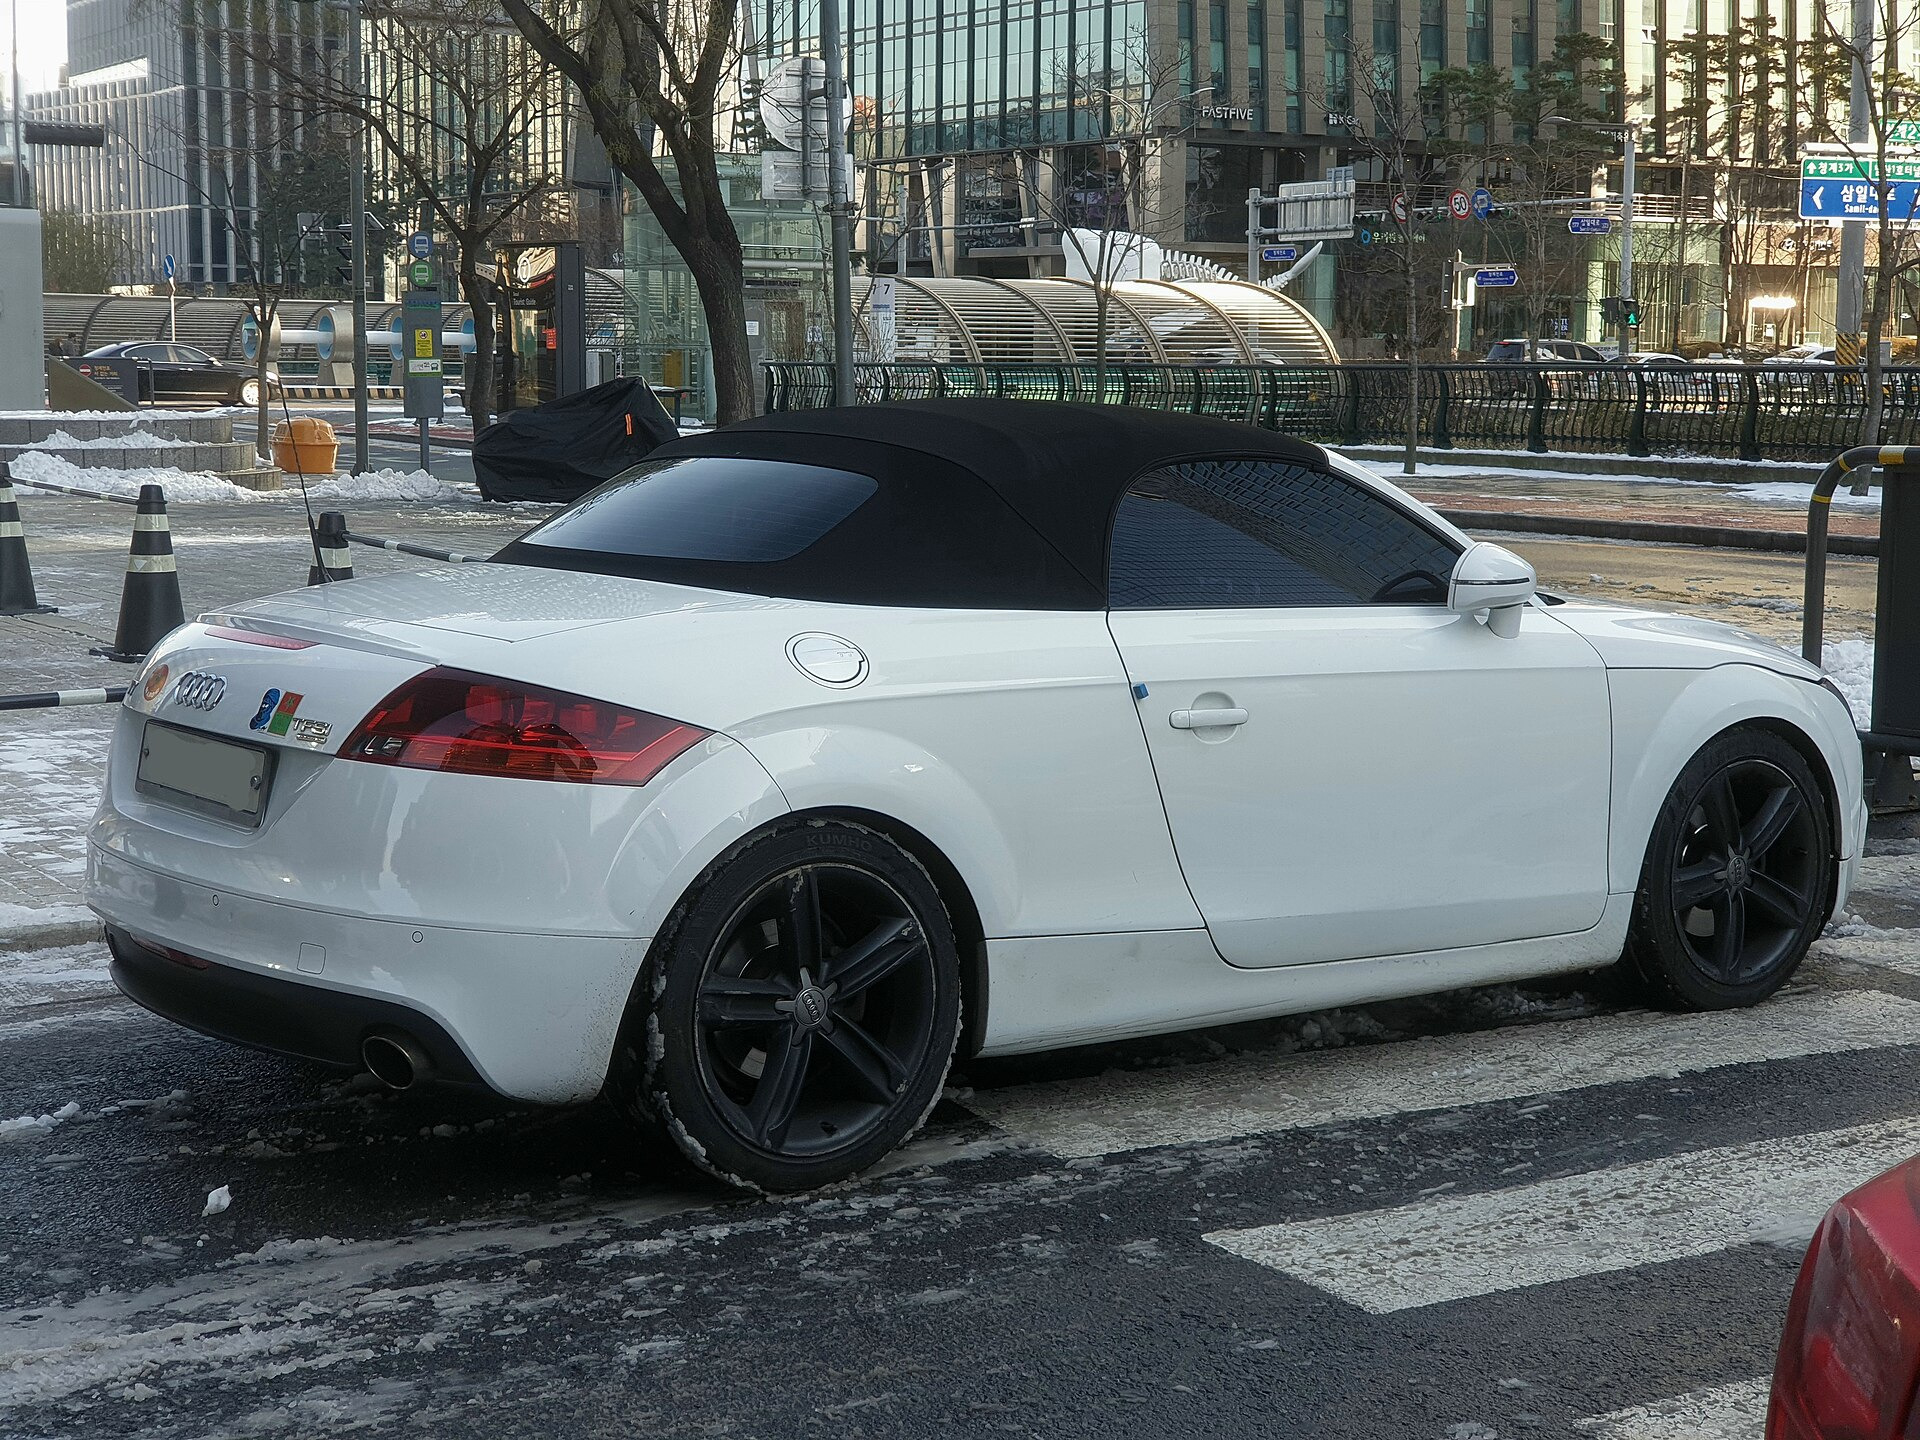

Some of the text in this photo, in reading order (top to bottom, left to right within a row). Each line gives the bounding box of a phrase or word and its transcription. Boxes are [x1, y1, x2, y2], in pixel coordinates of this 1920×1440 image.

[1202, 106, 1253, 120] FASTFIVE
[1818, 162, 1854, 174] 청계3가
[1453, 197, 1467, 211] 50
[1844, 204, 1889, 214] Samil-da
[884, 284, 890, 295] 7
[293, 718, 333, 736] TFSI
[806, 833, 873, 850] KUMHO
